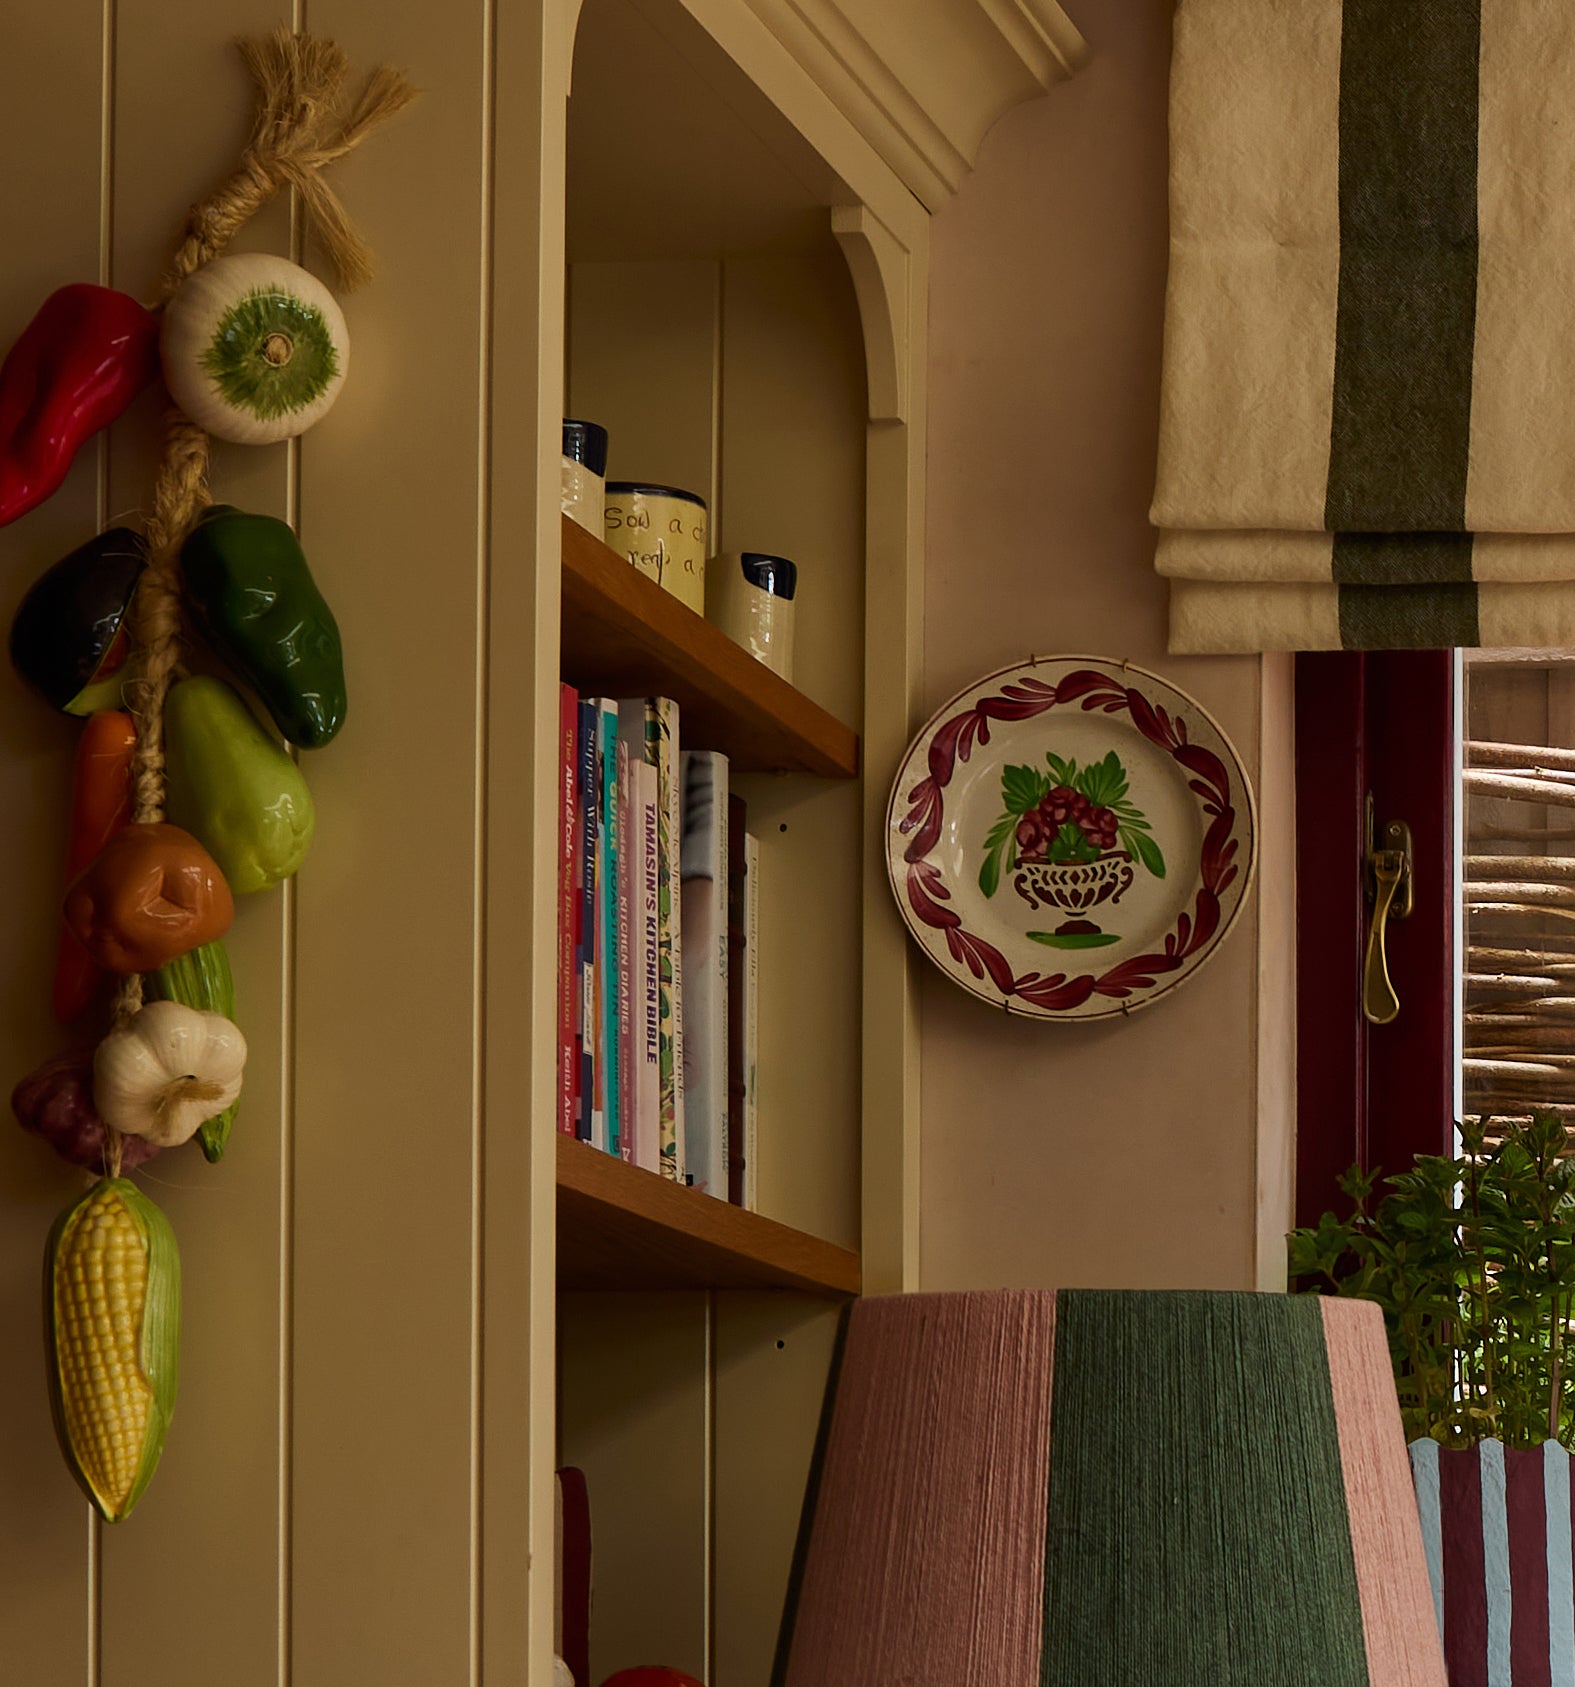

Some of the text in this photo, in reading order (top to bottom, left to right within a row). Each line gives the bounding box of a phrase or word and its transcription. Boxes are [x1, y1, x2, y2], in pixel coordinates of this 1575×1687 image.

[604, 507, 650, 531] Sow
[669, 518, 683, 535] a
[565, 730, 573, 760] The
[585, 728, 596, 798] Supper
[610, 735, 618, 774] THE
[565, 765, 574, 803] Abel
[586, 806, 596, 848] With
[609, 781, 617, 850] QUICK
[565, 823, 574, 859] Cole
[620, 896, 629, 965] KITCHEN
[646, 803, 657, 1064] TAMASIN'S KITCHEN BIBLE
[719, 936, 728, 979] EASY
[621, 970, 629, 1035] DIARIES
[564, 1045, 572, 1090] Keith
[564, 1095, 572, 1132] Abel
